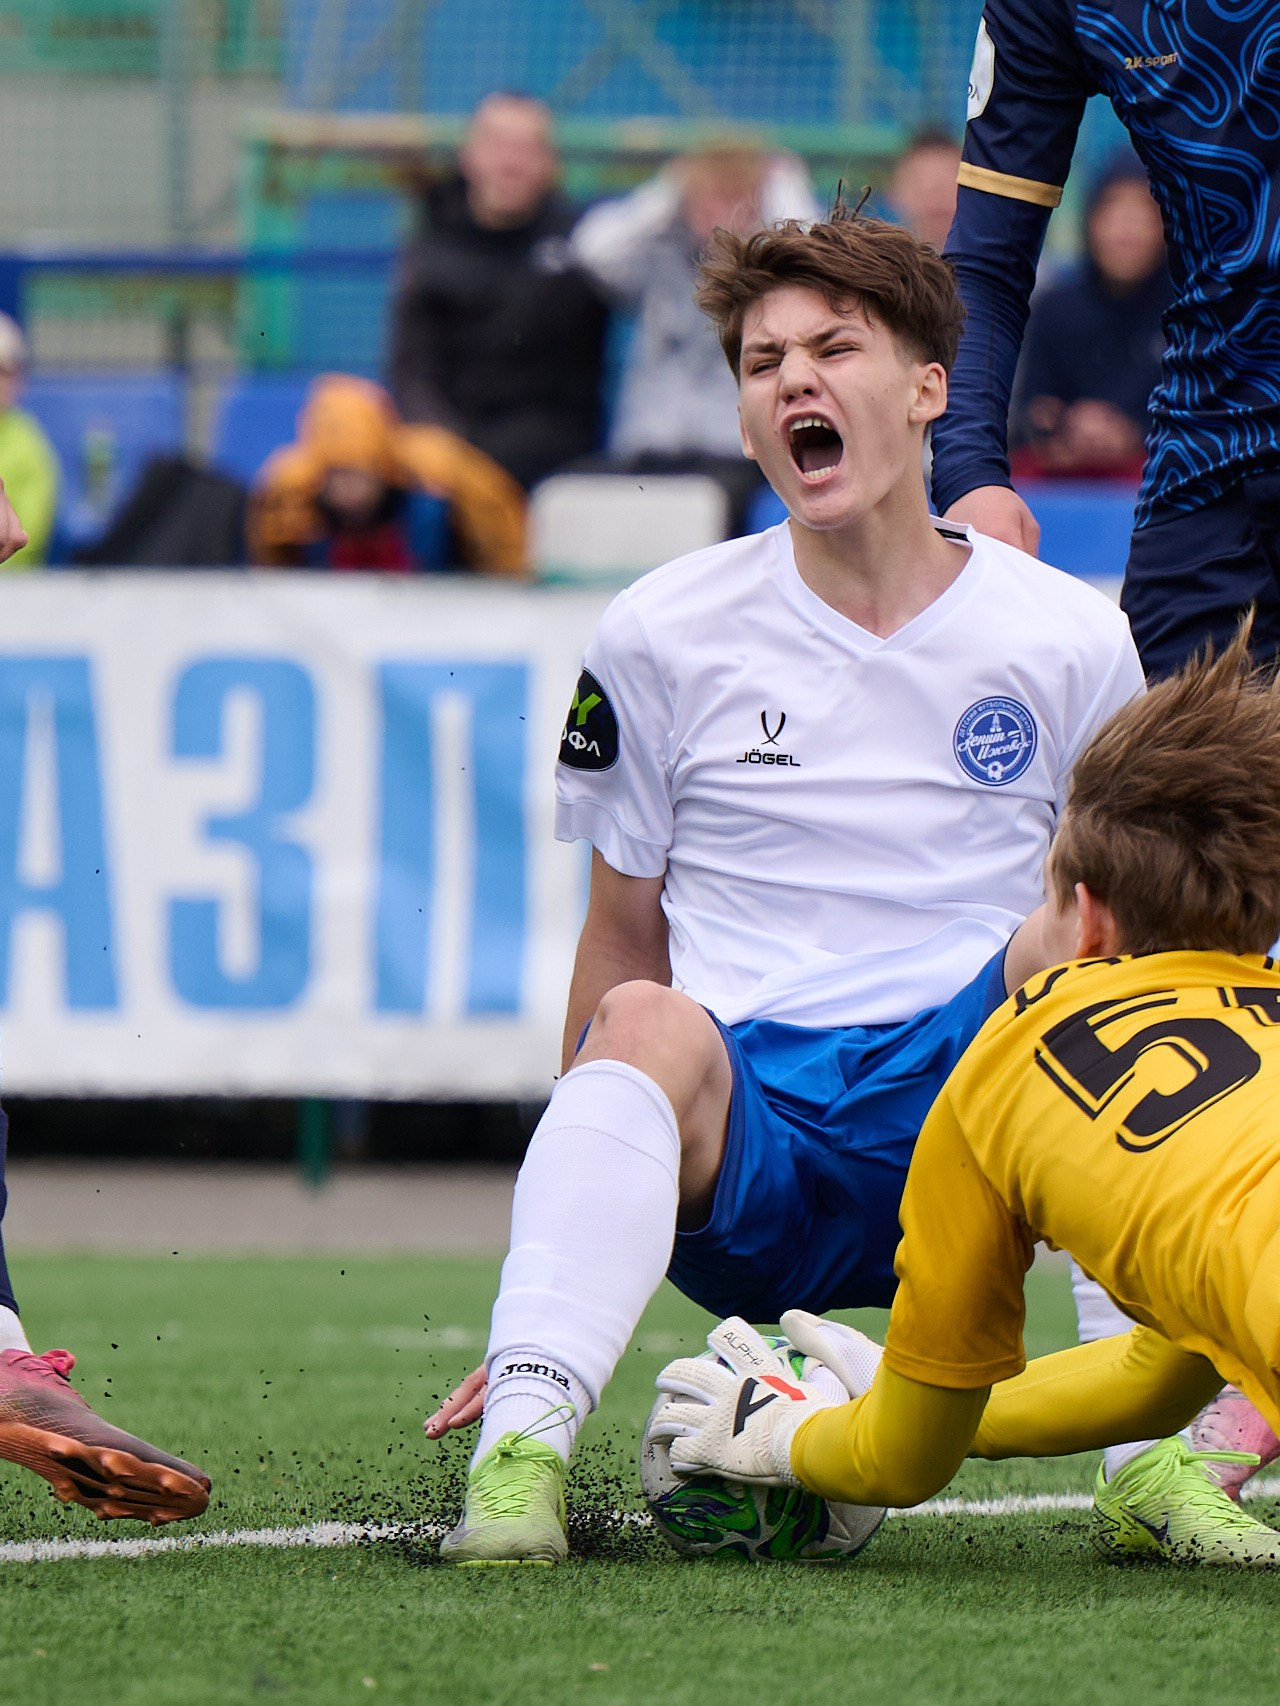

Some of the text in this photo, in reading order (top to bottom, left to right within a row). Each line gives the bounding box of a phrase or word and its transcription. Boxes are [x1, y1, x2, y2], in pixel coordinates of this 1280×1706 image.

[735, 748, 802, 767] JÖGEL
[0, 655, 593, 1016] АЗП
[723, 1331, 765, 1367] ALPHA
